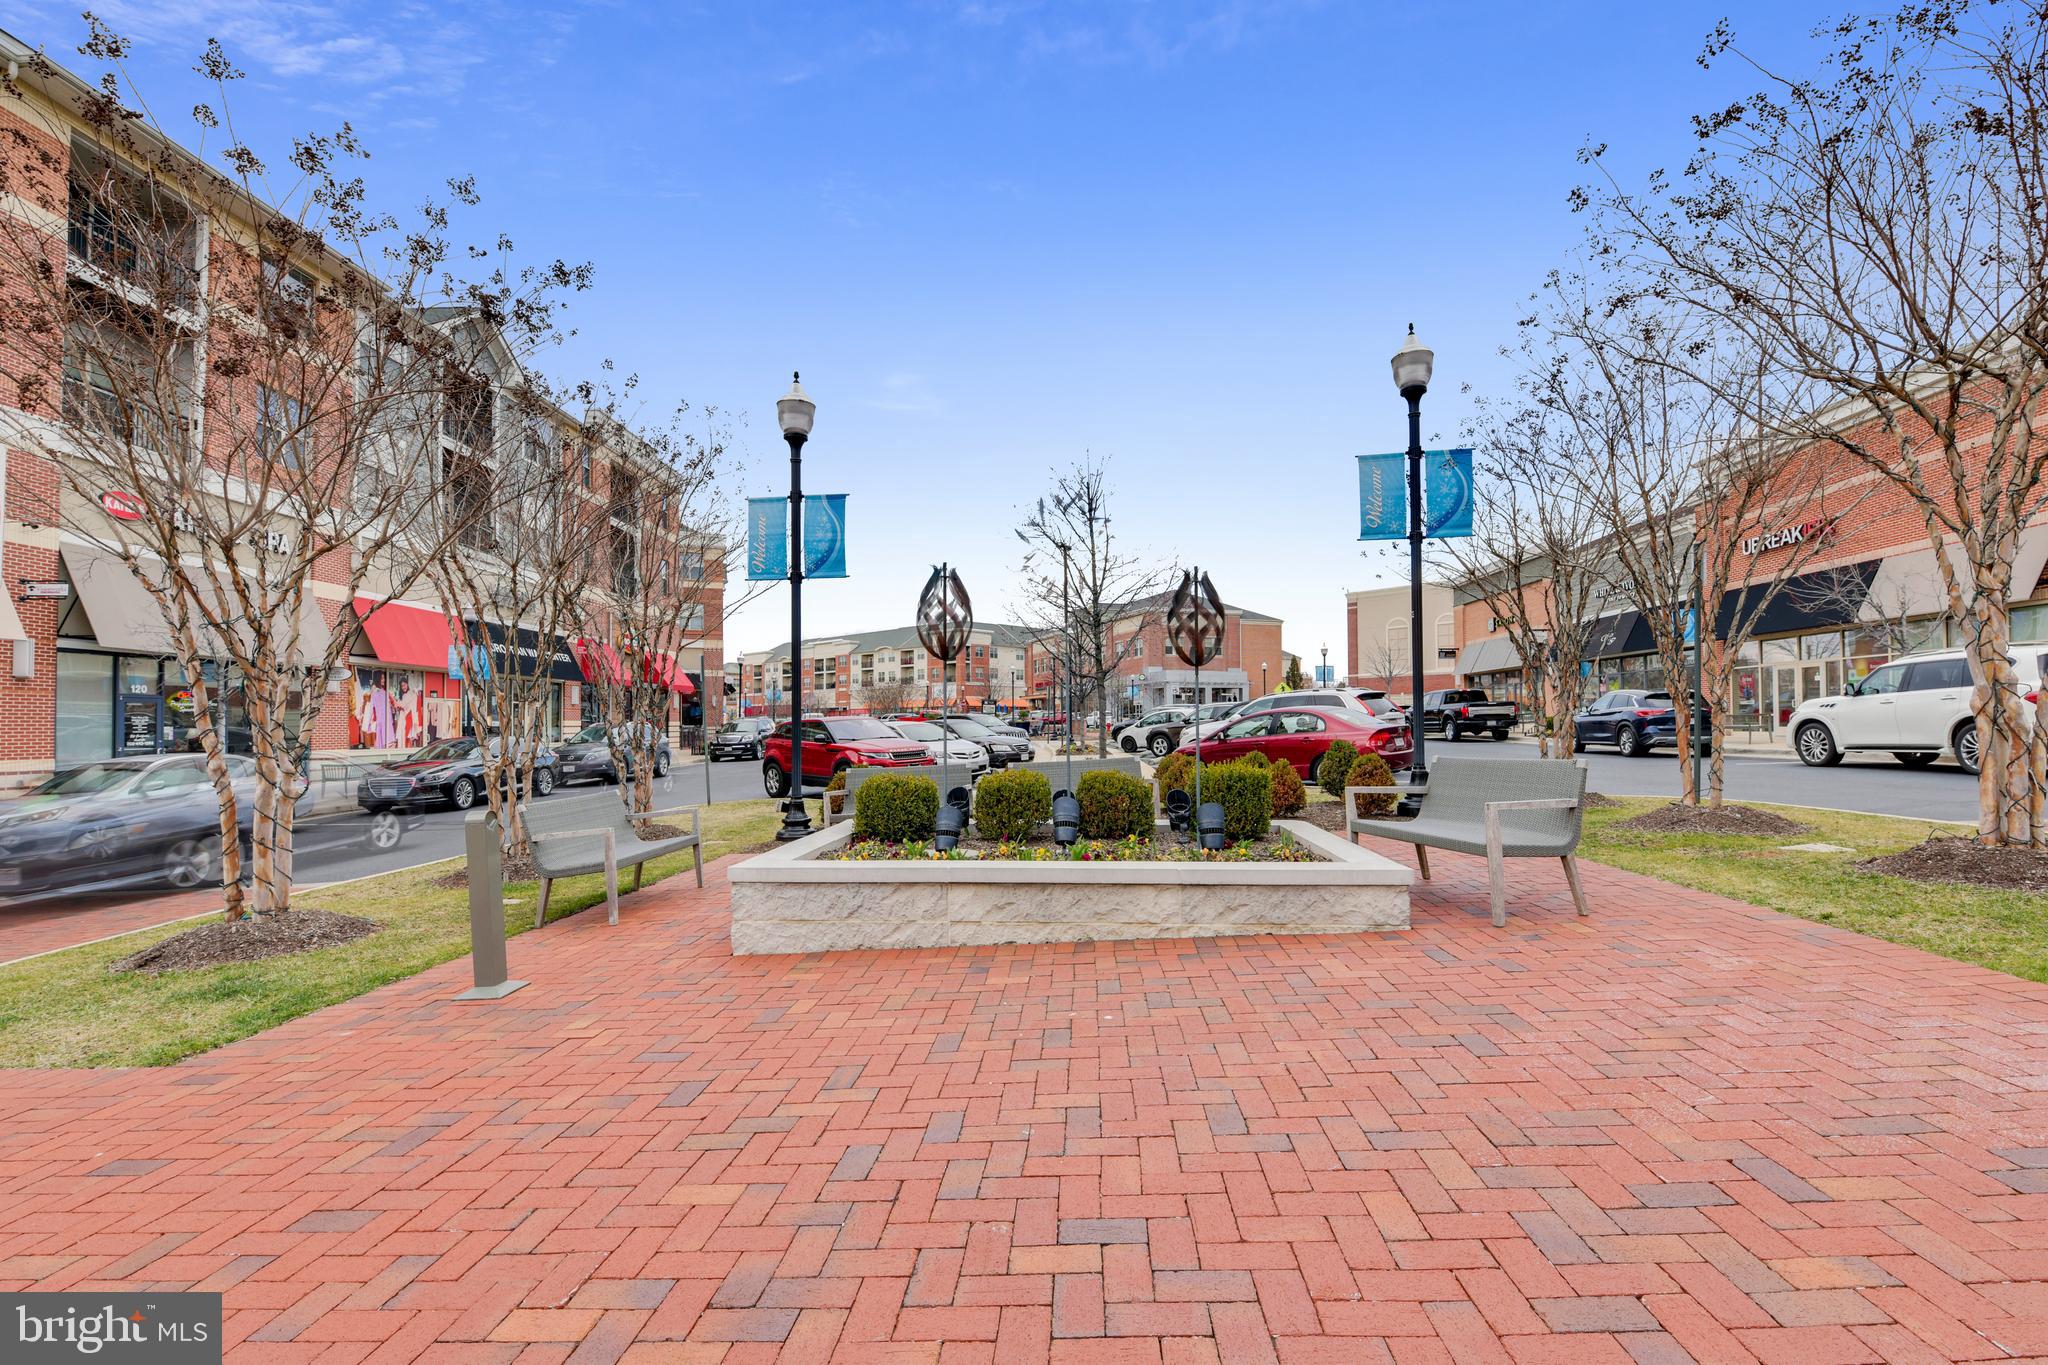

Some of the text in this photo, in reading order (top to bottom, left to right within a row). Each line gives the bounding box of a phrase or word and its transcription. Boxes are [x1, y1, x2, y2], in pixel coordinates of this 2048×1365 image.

[1365, 463, 1382, 528] Welcome
[751, 512, 767, 574] Welcome
[131, 685, 148, 694] 120
